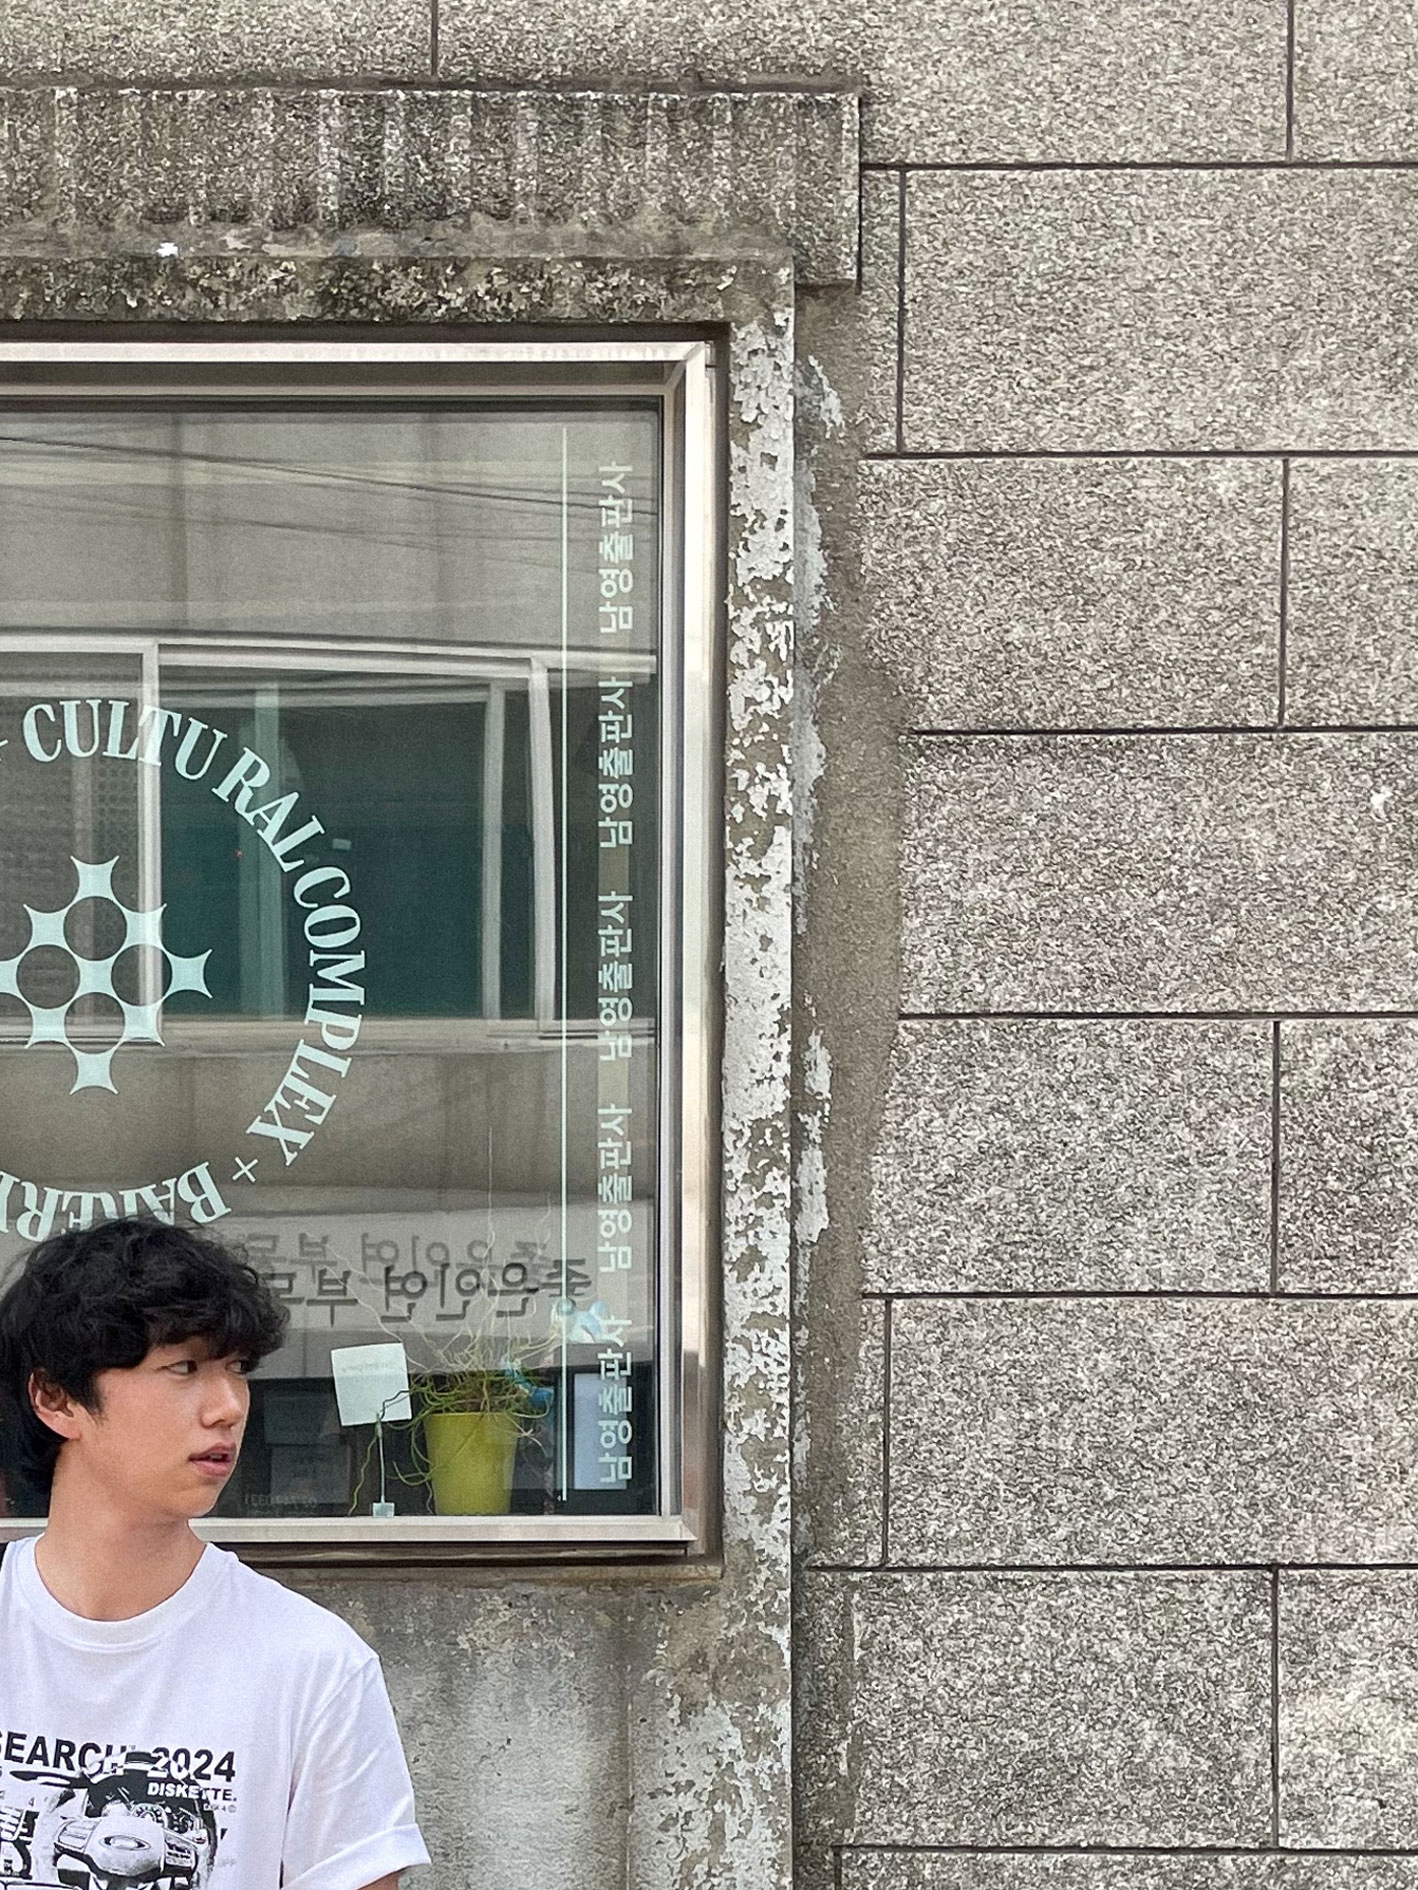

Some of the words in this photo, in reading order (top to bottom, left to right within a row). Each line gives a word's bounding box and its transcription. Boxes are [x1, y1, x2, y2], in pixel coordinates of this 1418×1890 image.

[598, 461, 633, 634] 남영출판사
[598, 677, 633, 848] 남영출판사
[245, 865, 366, 1166] COMPLEX
[598, 890, 633, 1062] 남영출판사
[598, 1104, 633, 1273] 남영출판사
[147, 1746, 236, 1782] 2024
